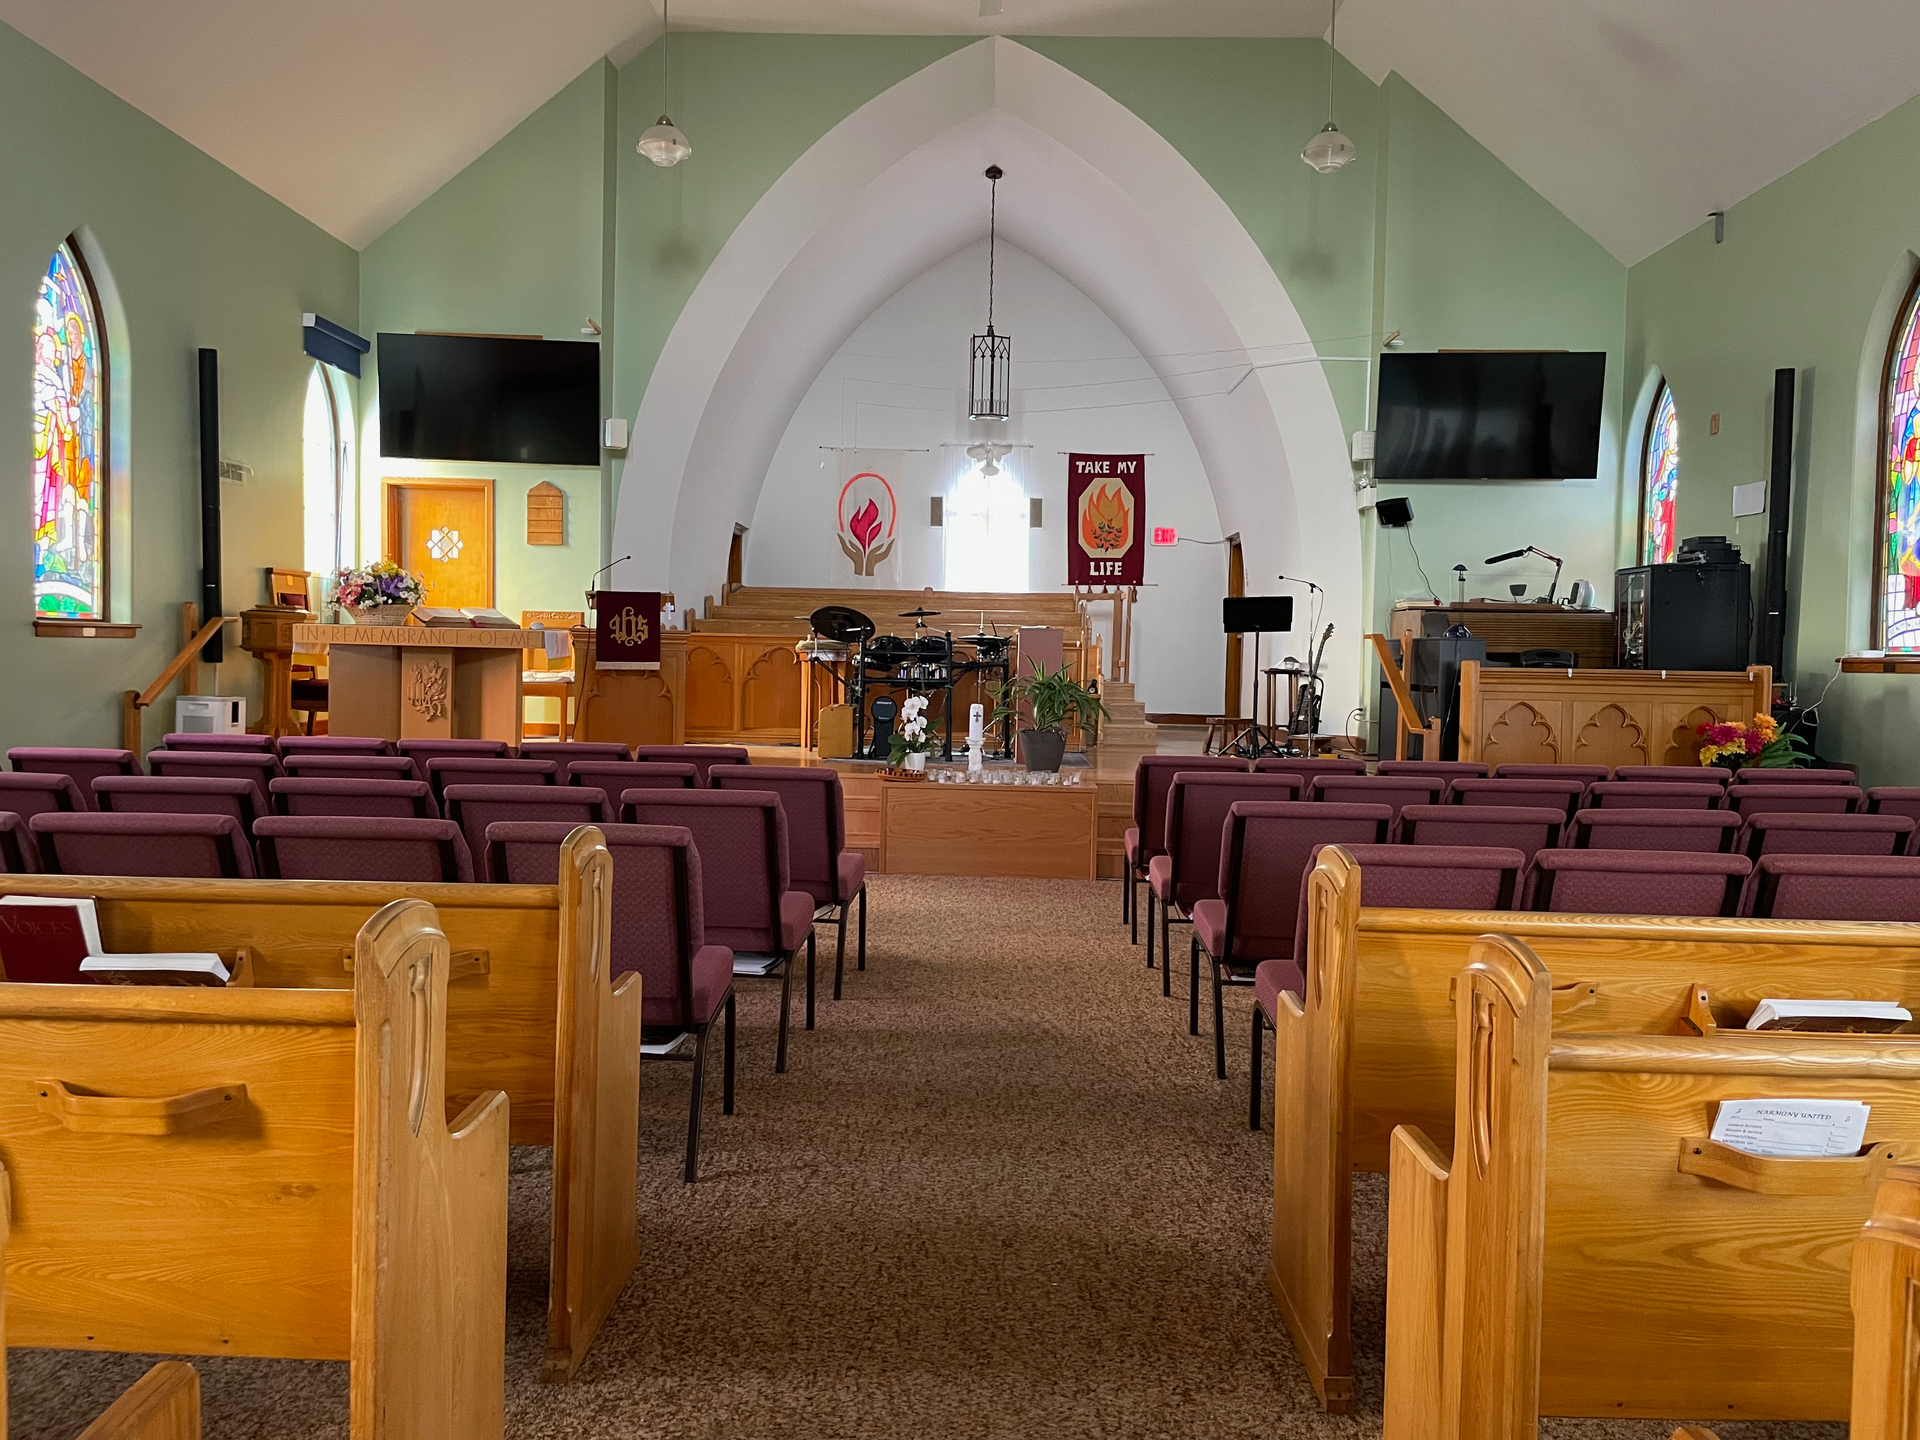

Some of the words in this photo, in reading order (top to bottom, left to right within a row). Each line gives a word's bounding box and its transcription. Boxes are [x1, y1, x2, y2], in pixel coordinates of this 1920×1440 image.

[1076, 461, 1110, 474] TAKE
[1117, 461, 1137, 474] MY
[1154, 527, 1176, 544] EXIT
[1089, 562, 1122, 576] LIFE
[331, 626, 464, 645] REMEMBRANCE
[479, 630, 501, 646] OF
[1755, 1109, 1799, 1118] HARMONY
[1800, 1112, 1832, 1120] UNITED
